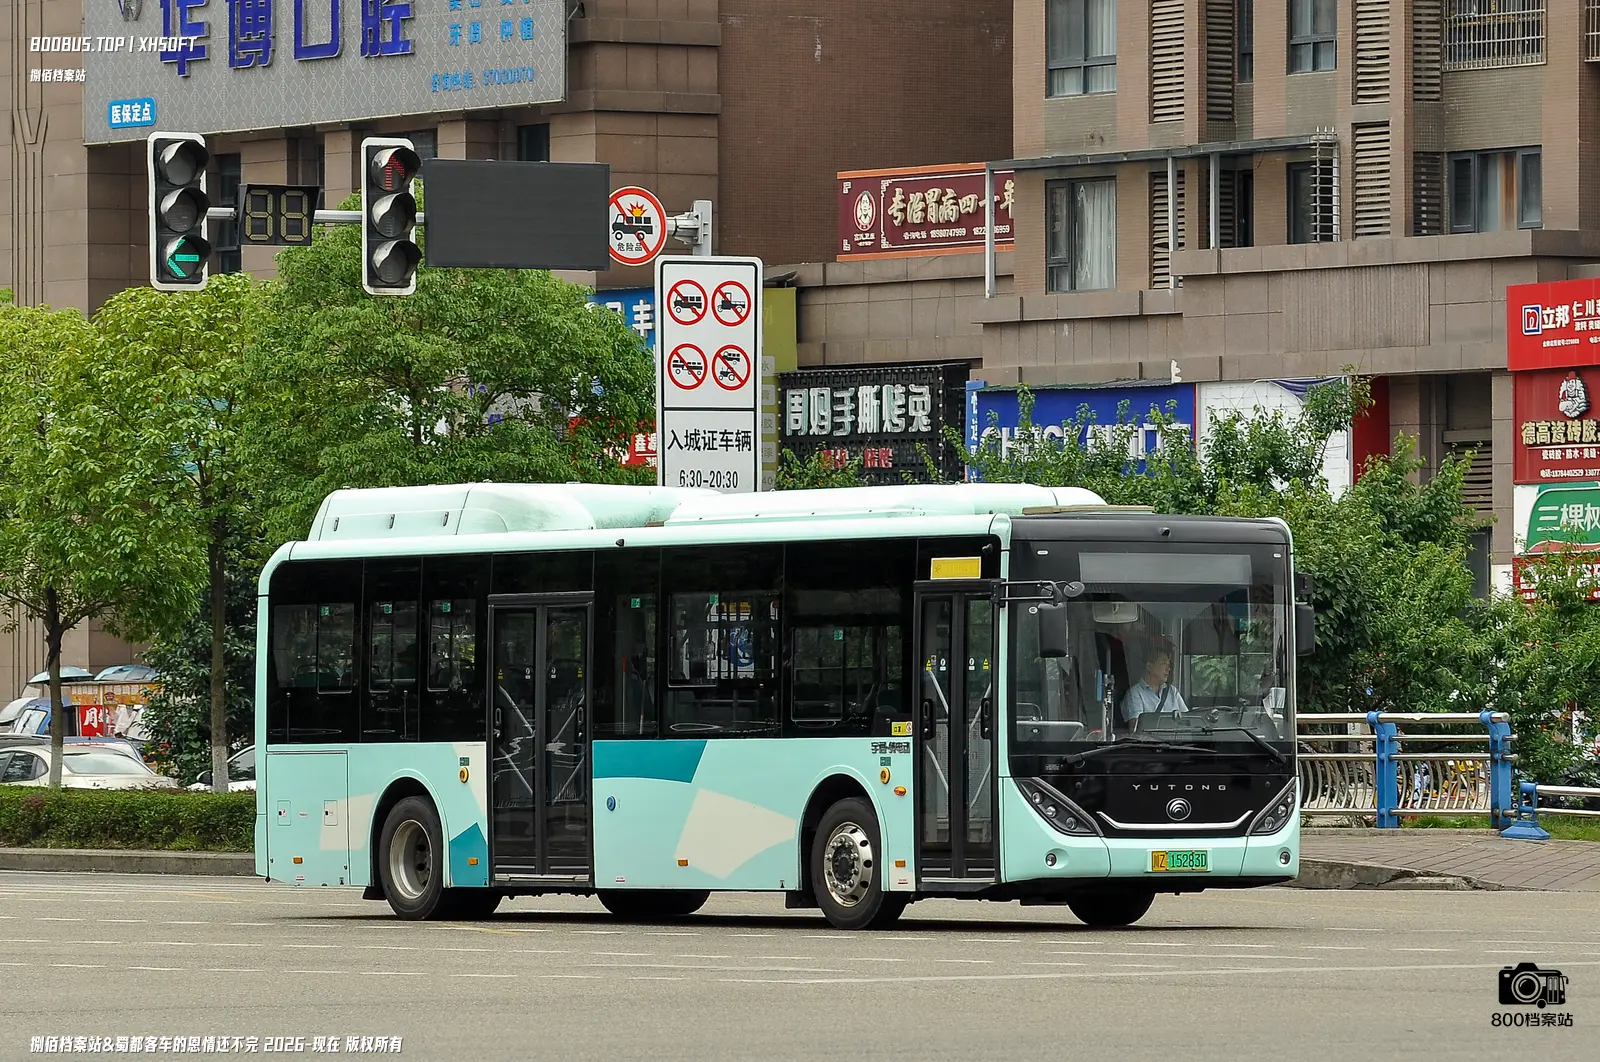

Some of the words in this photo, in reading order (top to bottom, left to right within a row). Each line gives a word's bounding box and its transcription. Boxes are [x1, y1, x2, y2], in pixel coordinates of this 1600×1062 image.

[111, 102, 152, 124] 医保定点
[617, 242, 643, 252] 危险品
[1541, 304, 1570, 329] 立邦
[667, 428, 752, 452] 入城证车辆
[1521, 419, 1600, 445] 德高瓷砖胶
[679, 469, 739, 488] 6:30-20:30
[1171, 852, 1207, 868] 15283D
